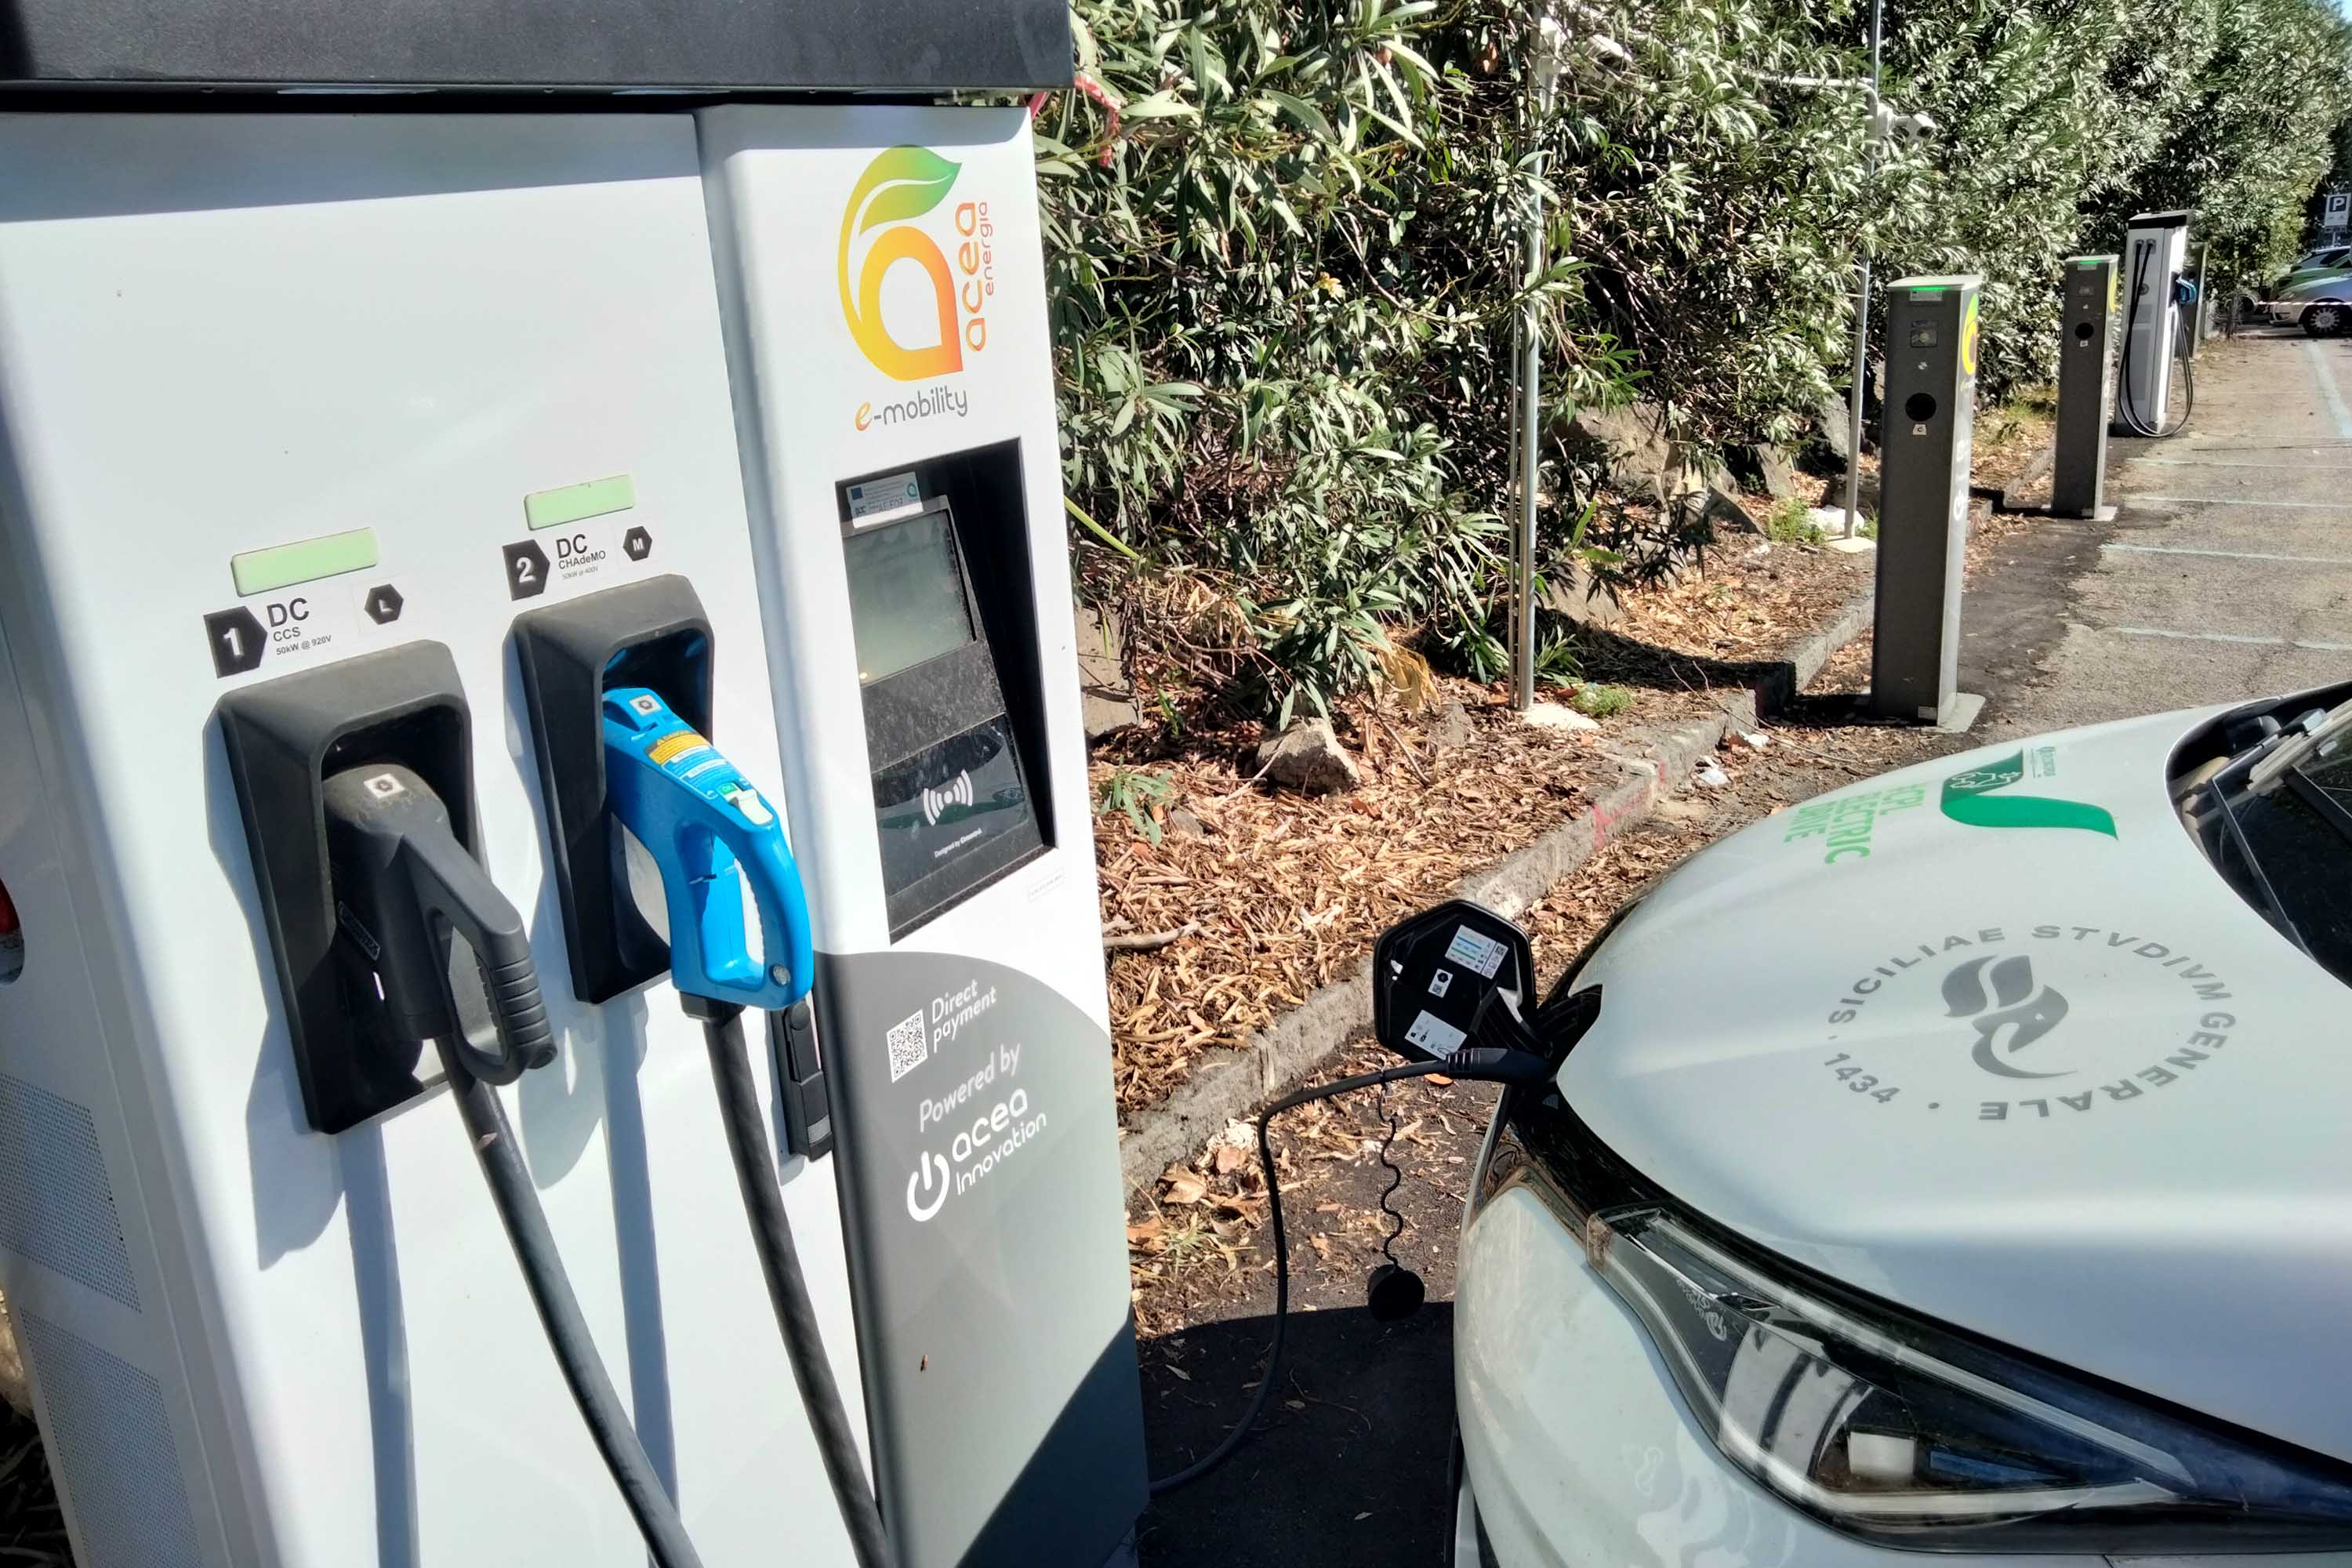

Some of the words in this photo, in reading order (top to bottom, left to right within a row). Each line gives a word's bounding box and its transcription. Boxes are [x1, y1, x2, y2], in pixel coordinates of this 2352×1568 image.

[2332, 197, 2345, 211] P
[978, 201, 994, 296] energia
[955, 201, 986, 352] acea
[855, 385, 968, 432] e-mobility
[556, 534, 587, 559] DC
[558, 550, 607, 570] CHAdeMO
[633, 538, 644, 552] M
[516, 557, 536, 583] 2
[267, 597, 310, 627] DC
[379, 599, 393, 612] L
[223, 627, 245, 658] 1
[273, 627, 301, 641] CCS
[277, 644, 299, 655] 50kW
[301, 641, 310, 650] @
[311, 635, 332, 647] 920V
[1828, 927, 2005, 1024] SICILIAE
[2031, 925, 2234, 1000] STVDIVM
[931, 979, 978, 1025] Direct
[933, 986, 997, 1054] payment
[920, 1051, 995, 1133] Powered
[1000, 1044, 1020, 1077] by
[1824, 1053, 1900, 1103] 1434
[1978, 1011, 2237, 1120] GENERALE
[952, 1088, 1029, 1163] acea
[956, 1112, 1047, 1196] Innovation
